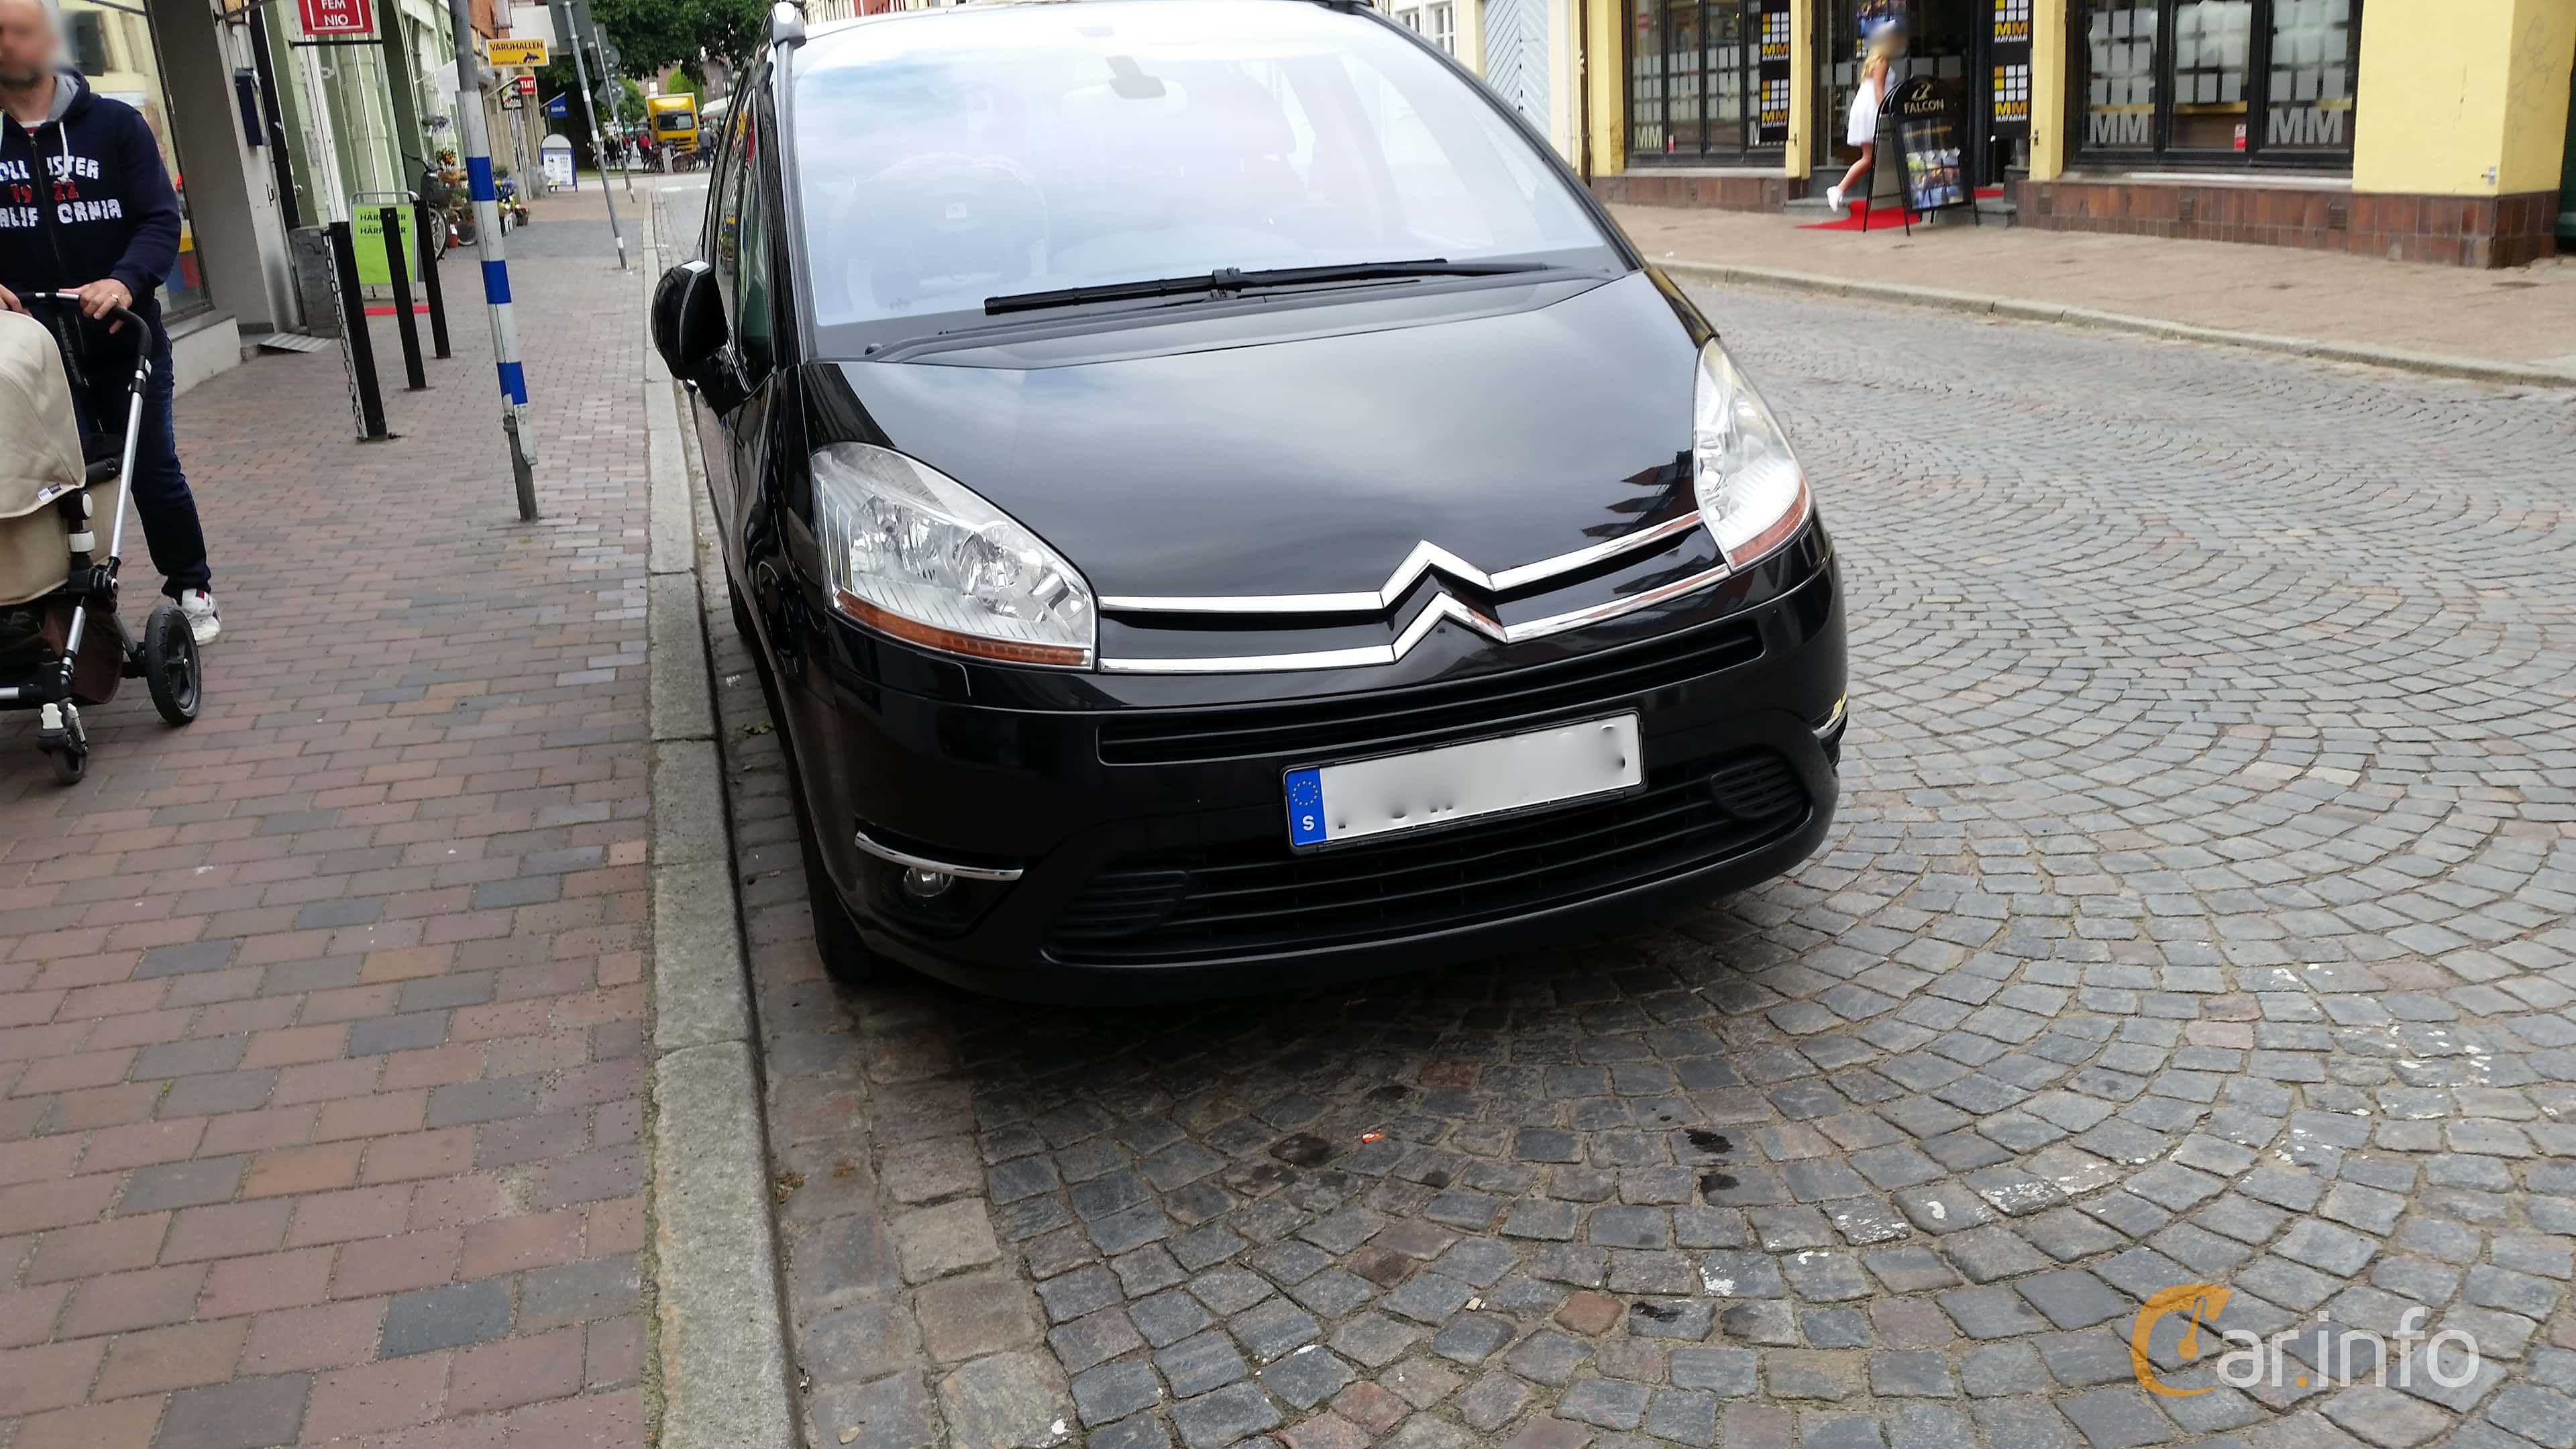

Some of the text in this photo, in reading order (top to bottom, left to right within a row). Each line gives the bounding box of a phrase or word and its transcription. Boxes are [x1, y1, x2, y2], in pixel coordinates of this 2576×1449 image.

[321, 0, 346, 9] FEM
[324, 13, 349, 26] NIO
[1994, 21, 2029, 36] MM
[490, 41, 543, 51] VARUHALLEN
[1762, 43, 1789, 54] MM
[1904, 99, 1944, 115] FALCON
[1994, 101, 2028, 115] MM
[1762, 110, 1788, 122] MM
[2089, 111, 2148, 144] MM
[2269, 107, 2343, 144] MM
[1635, 125, 1662, 148] MM
[46, 155, 99, 179] ISTER
[11, 178, 80, 203] 19 22
[57, 199, 122, 224] ORNIA
[1302, 814, 1315, 831] S
